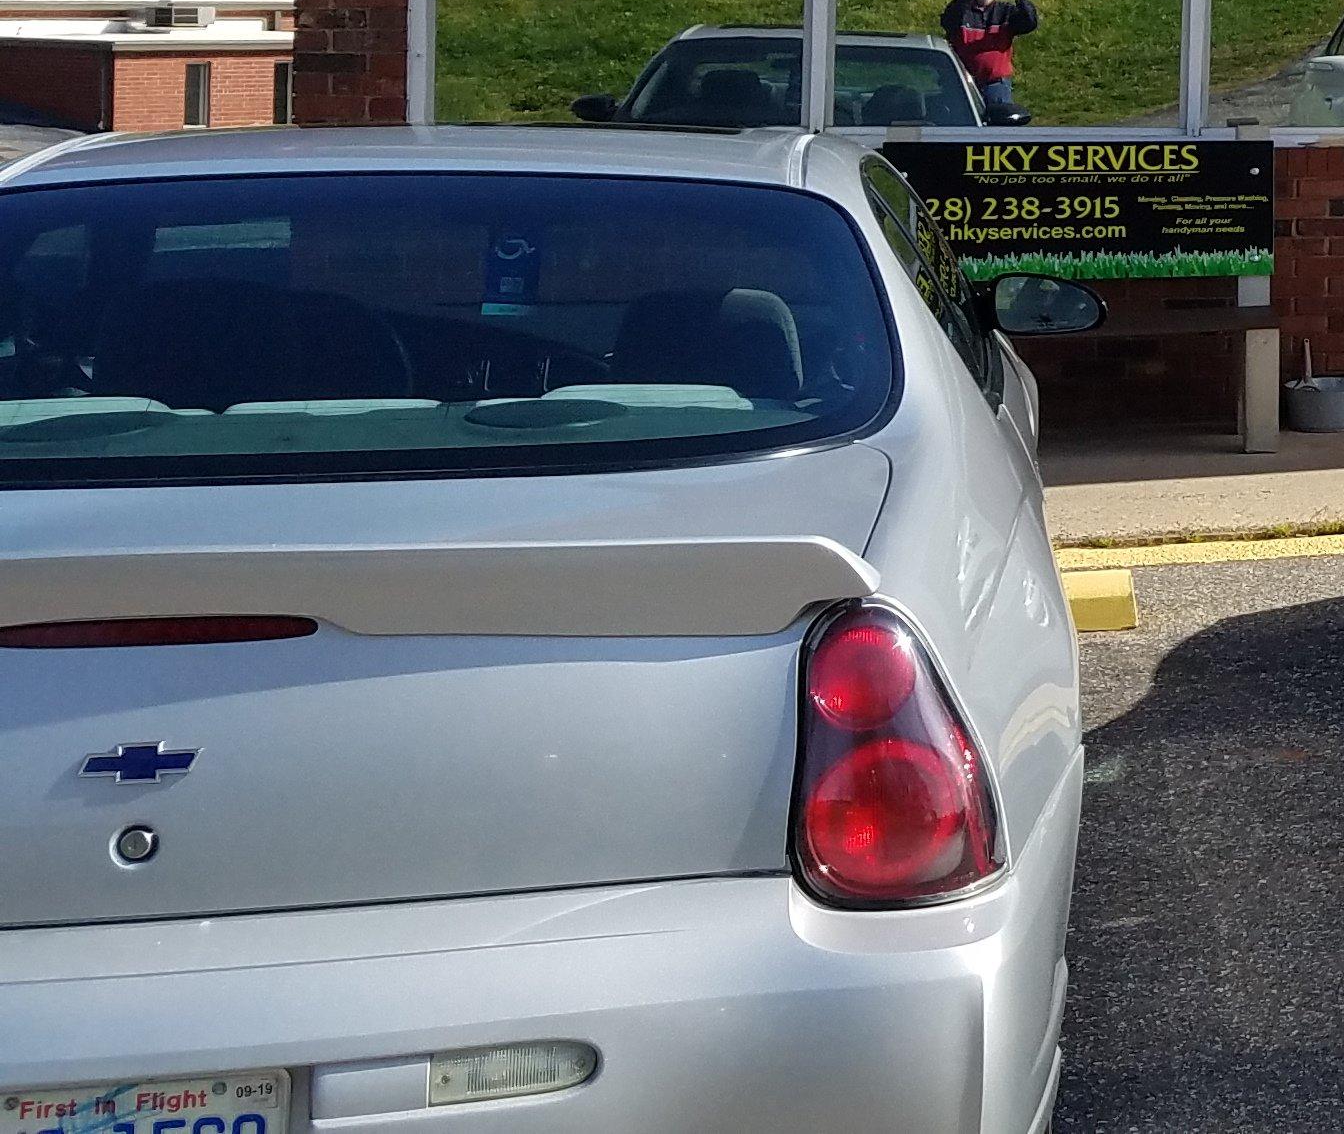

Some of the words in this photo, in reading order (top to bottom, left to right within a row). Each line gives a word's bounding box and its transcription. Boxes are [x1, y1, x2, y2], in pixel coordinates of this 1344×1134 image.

[965, 145, 1040, 172] HKY
[1047, 144, 1199, 171] SERVICES
[1032, 176, 1055, 184] too
[1131, 174, 1149, 183] do
[981, 196, 1121, 220] 238-3915
[1162, 226, 1214, 235] handyman
[1215, 225, 1245, 233] needs
[1176, 217, 1193, 225] For
[1195, 217, 1207, 225] all
[1209, 218, 1233, 226] your
[939, 222, 1127, 244] .hkyservices.com
[235, 1083, 273, 1098] 09-19
[19, 1099, 77, 1120] First
[136, 1089, 207, 1114] Flight
